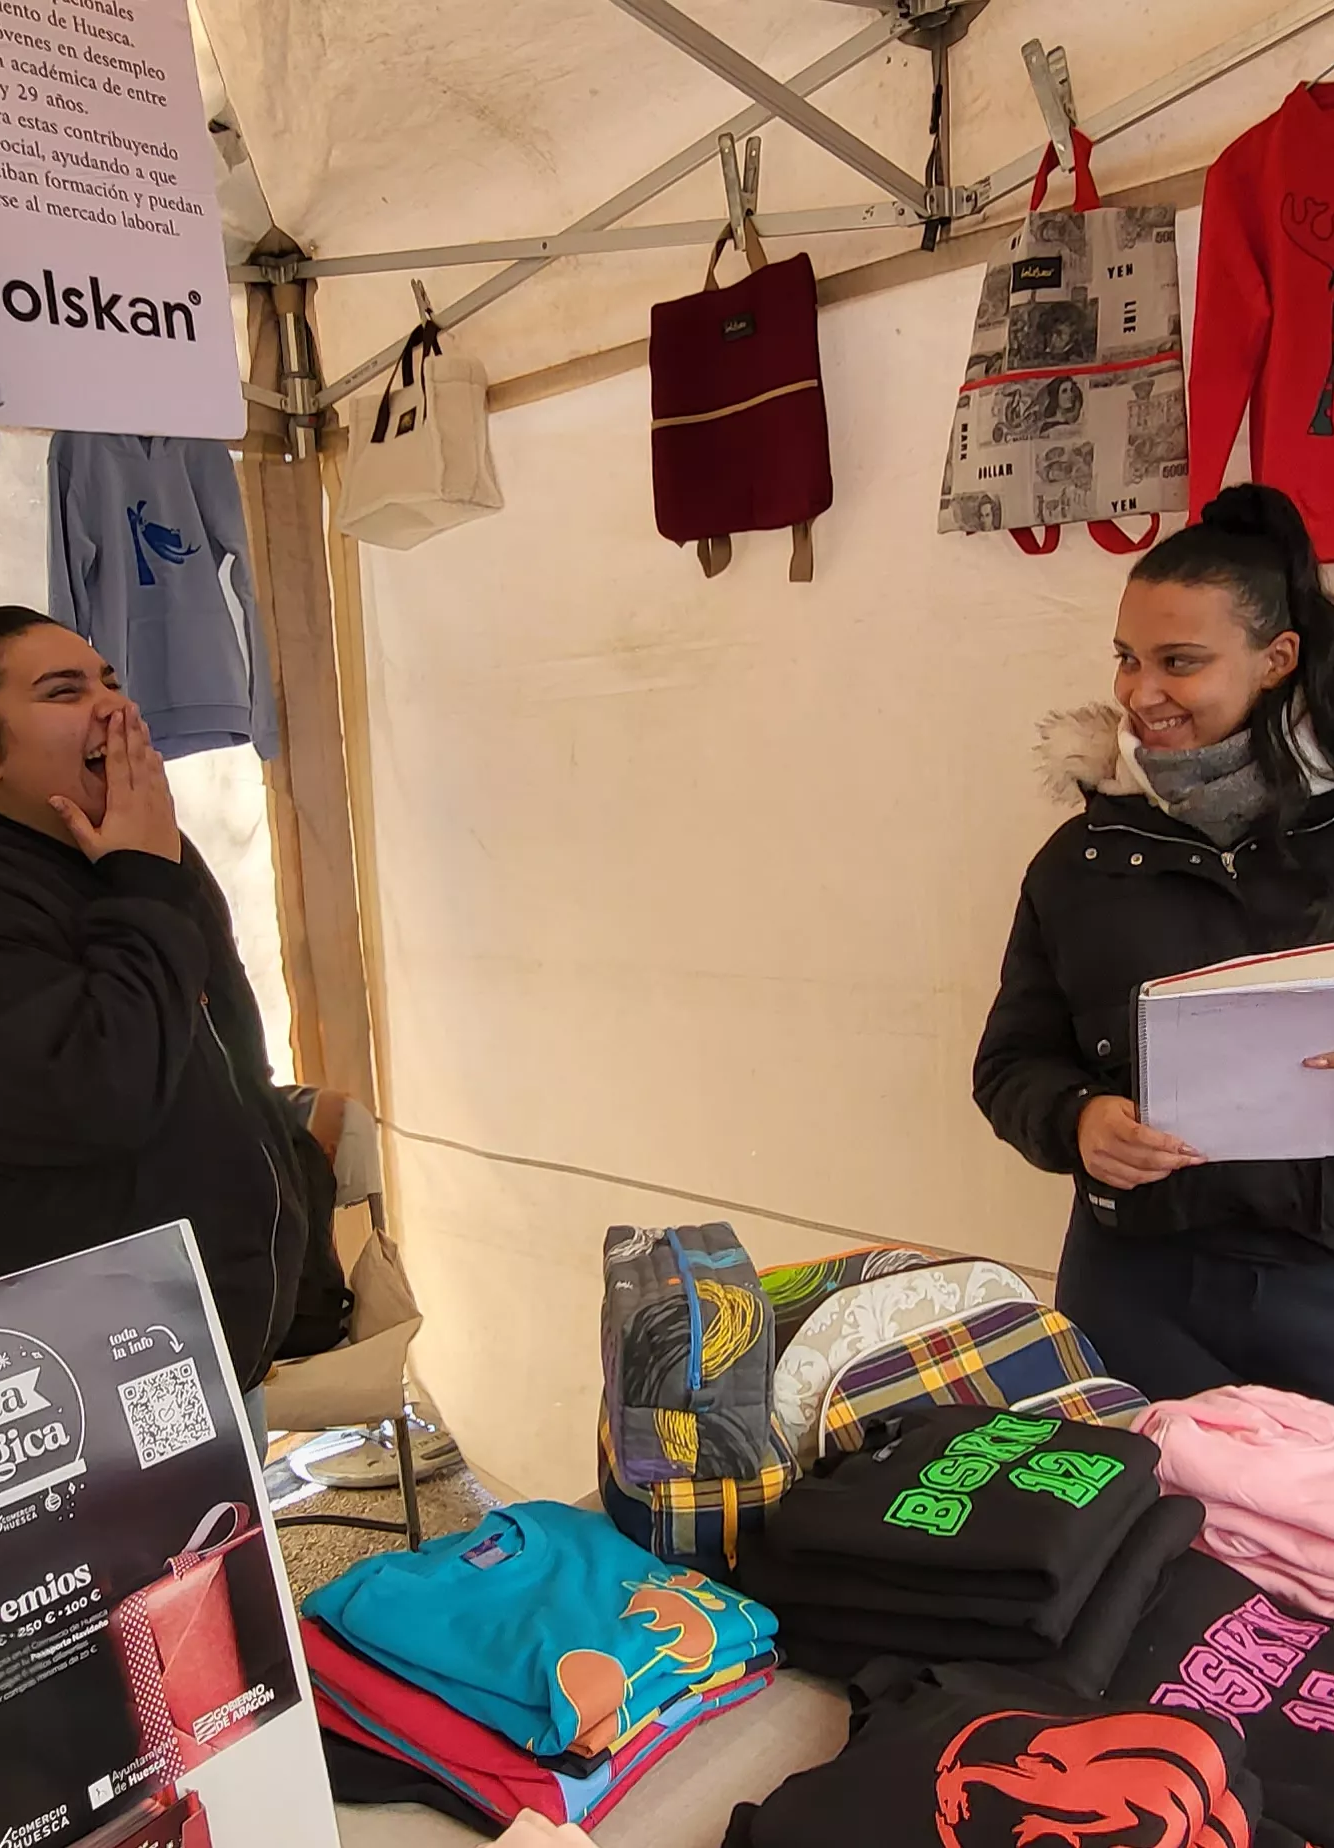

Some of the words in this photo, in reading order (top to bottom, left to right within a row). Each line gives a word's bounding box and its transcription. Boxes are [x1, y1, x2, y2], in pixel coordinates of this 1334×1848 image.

[47, 9, 67, 29] de
[72, 15, 135, 48] Huesca.
[57, 42, 79, 59] en
[83, 46, 166, 82] desempleo
[0, 83, 9, 100] y
[17, 83, 39, 101] 29
[46, 93, 89, 115] años.
[11, 59, 98, 91] académica
[103, 77, 122, 96] de
[127, 87, 167, 107] entre
[17, 114, 58, 135] estas
[64, 125, 179, 160] contribuyendo
[51, 149, 130, 176] ayudando
[135, 167, 145, 180] a
[149, 170, 177, 187] que
[45, 171, 129, 202] formación
[134, 192, 143, 208] y
[148, 194, 205, 216] puedan
[25, 195, 40, 213] al
[46, 202, 117, 226] mercado
[121, 210, 180, 236] laboral.
[1107, 263, 1133, 279] YEN
[1111, 497, 1136, 513] YEN
[109, 1328, 138, 1346] toda
[112, 1347, 126, 1360] la
[128, 1337, 153, 1354] info
[1008, 1452, 1125, 1509] 12
[2, 1504, 36, 1524] COMERCIO
[3, 1512, 38, 1532] HUESCA
[17, 1619, 42, 1638] 250
[64, 1597, 88, 1615] 100
[214, 1684, 265, 1720] GOBIERNO
[216, 1716, 230, 1732] DE
[114, 1782, 127, 1795] de
[128, 1757, 166, 1787] Huesca
[11, 1804, 67, 1840] COMERCIO
[14, 1816, 70, 1848] HUESCA
